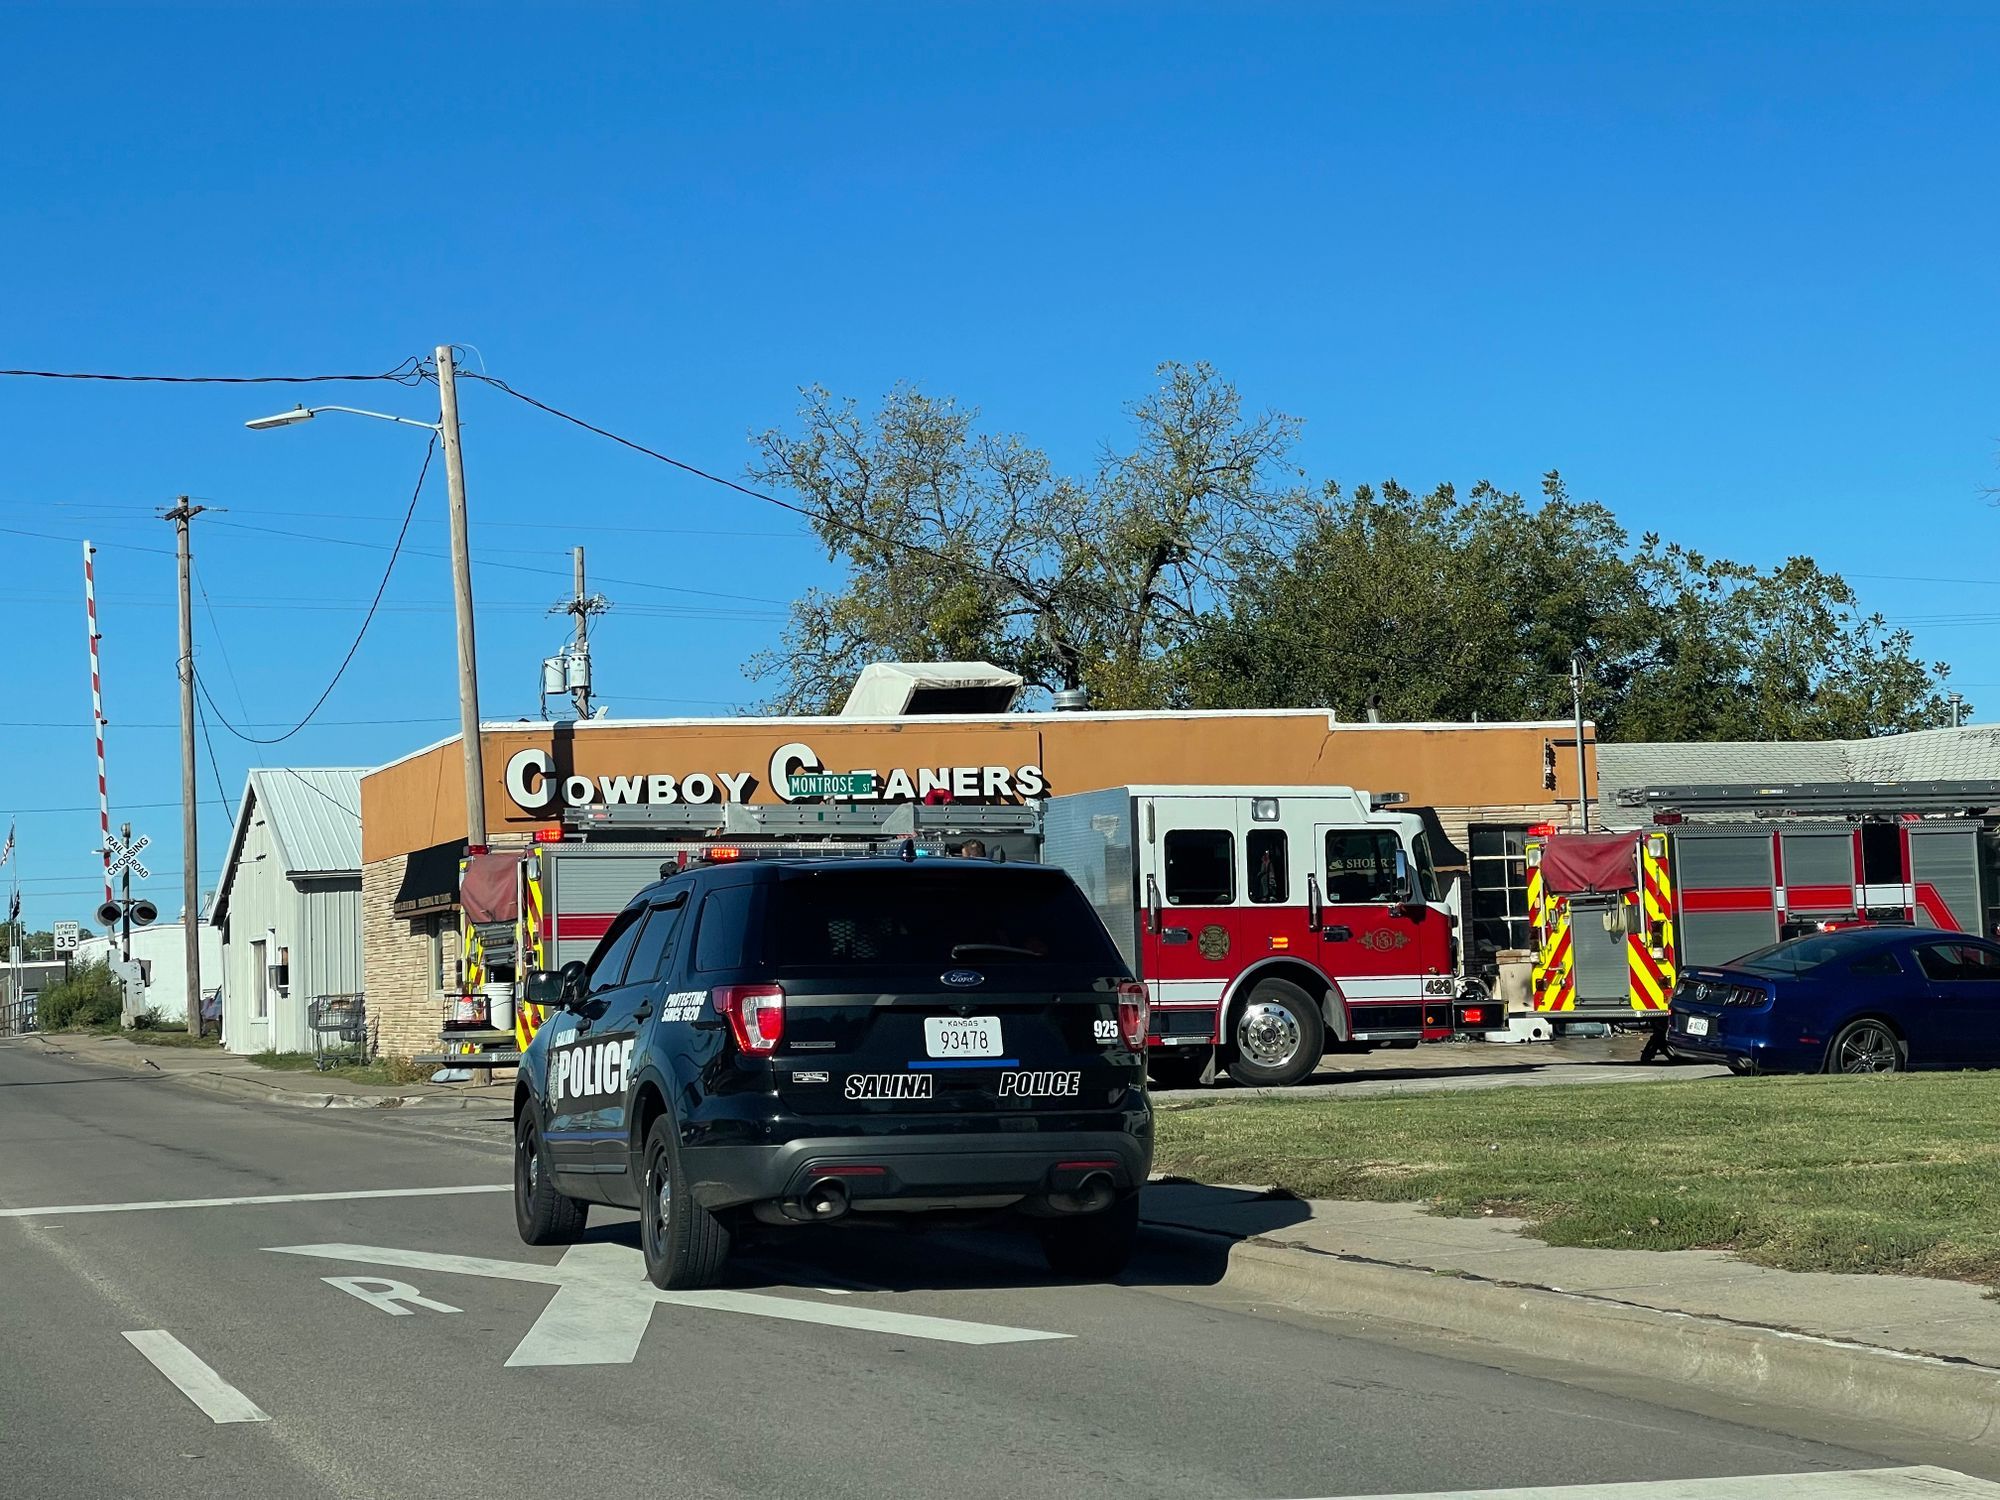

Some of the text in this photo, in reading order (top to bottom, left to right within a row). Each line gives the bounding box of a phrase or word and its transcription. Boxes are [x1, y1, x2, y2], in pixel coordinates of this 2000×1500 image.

[506, 743, 1043, 808] COWBOY CEANERS
[791, 776, 870, 793] MONTROSE ST
[106, 835, 149, 878] RAIL ROAD
[107, 837, 149, 876] CROSSING
[56, 936, 77, 948] 35
[1425, 979, 1452, 995] 429
[941, 1030, 988, 1050] 93478
[1093, 1019, 1119, 1038] 925
[558, 1039, 635, 1099] POLICE
[845, 1074, 933, 1100] SALINA
[998, 1071, 1081, 1097] POLICE
[319, 1276, 465, 1316] R
